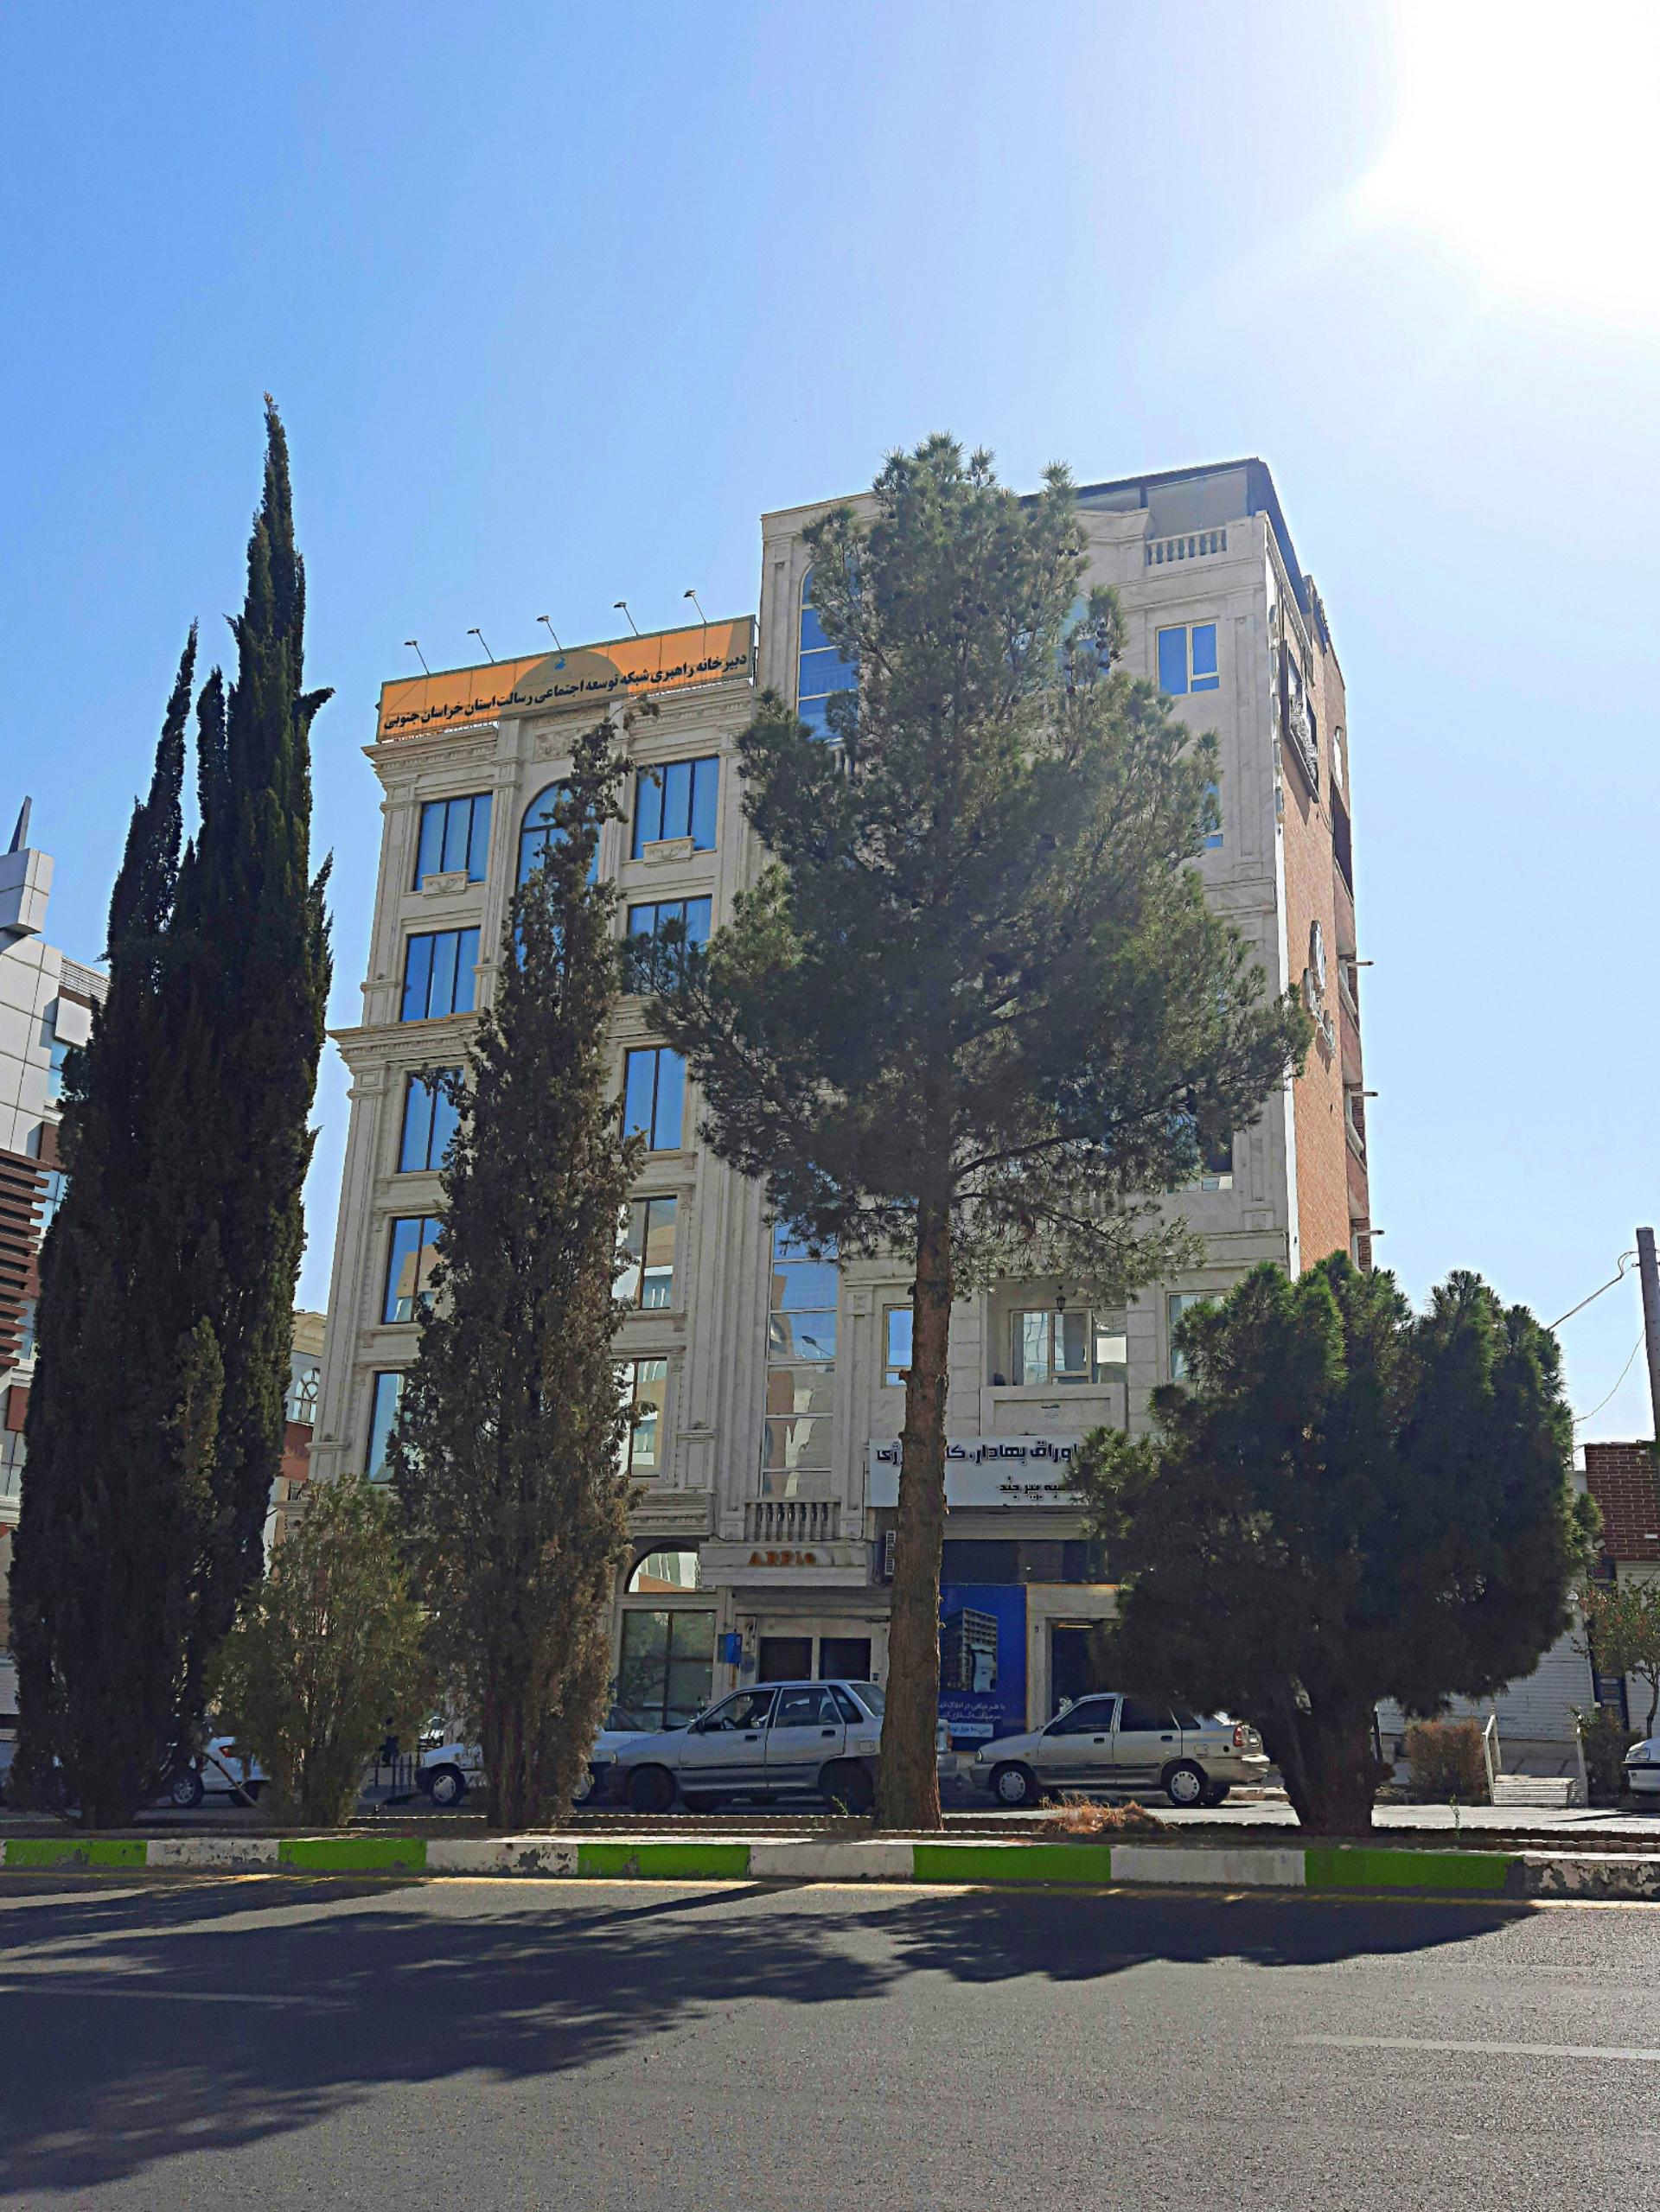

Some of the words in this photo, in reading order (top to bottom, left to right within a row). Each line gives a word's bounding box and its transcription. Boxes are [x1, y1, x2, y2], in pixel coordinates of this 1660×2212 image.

[650, 662, 694, 684] راهبری
[697, 653, 747, 673] دبیرخانه
[585, 673, 619, 692] توسعه
[621, 669, 649, 686] شبکه
[497, 692, 533, 707] رسالت
[534, 679, 584, 704] اجتماعی
[421, 702, 463, 724] خراسان
[463, 695, 495, 717] استان
[384, 712, 420, 730] جنوبی
